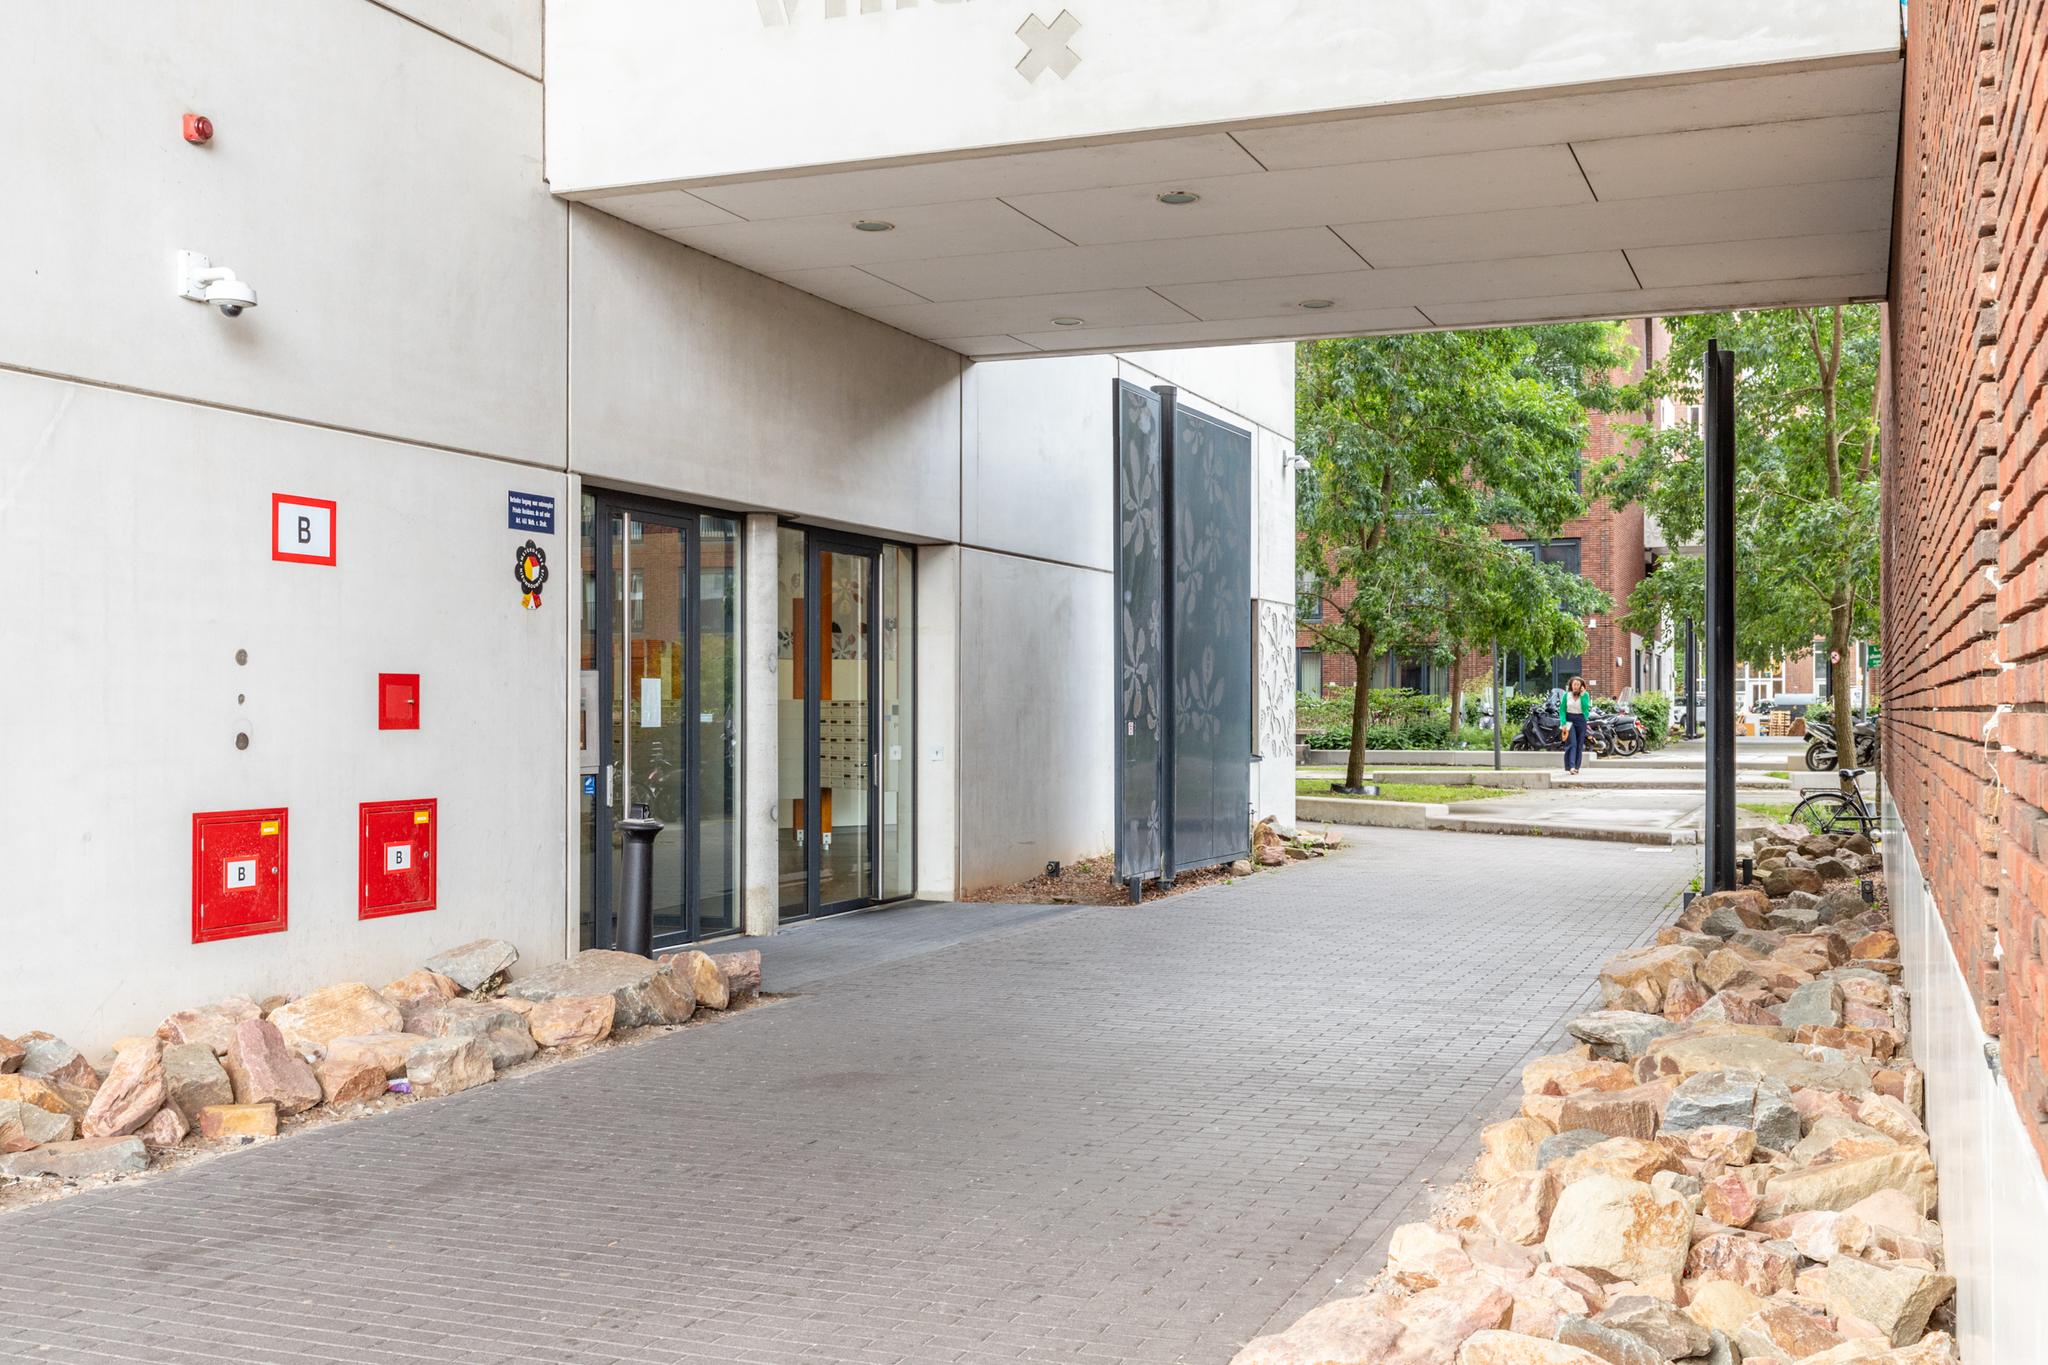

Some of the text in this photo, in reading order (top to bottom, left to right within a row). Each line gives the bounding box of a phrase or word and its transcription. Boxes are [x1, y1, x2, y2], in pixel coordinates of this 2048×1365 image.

[298, 516, 311, 544] B
[396, 851, 402, 864] B
[238, 867, 245, 881] B
